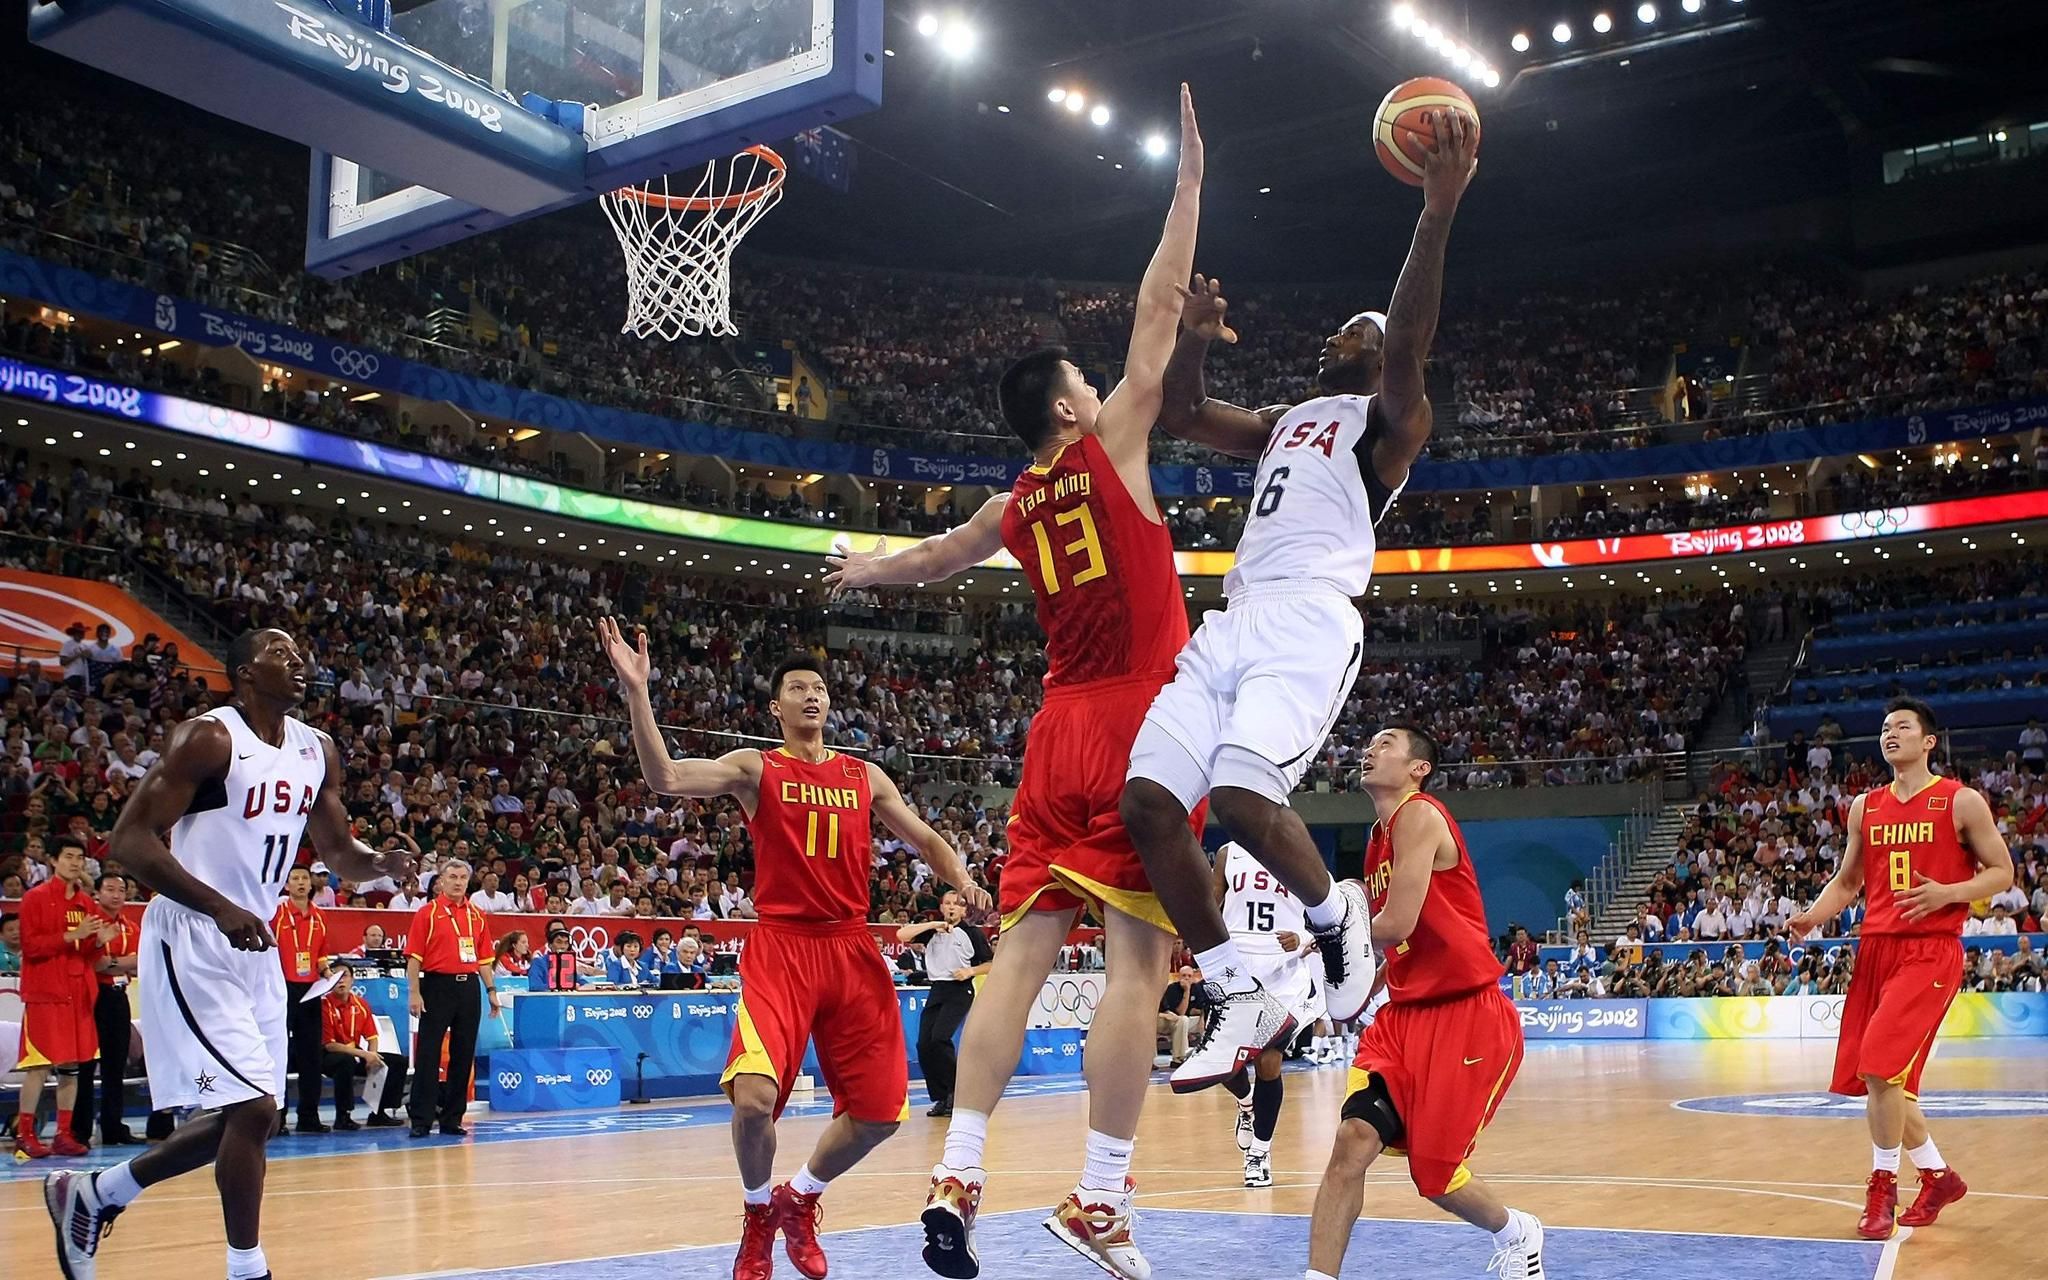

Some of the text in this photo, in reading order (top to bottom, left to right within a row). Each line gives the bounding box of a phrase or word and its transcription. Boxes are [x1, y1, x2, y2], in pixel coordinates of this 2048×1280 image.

[274, 1, 503, 133] Beijing 2008
[200, 312, 314, 361] Beijing 2008
[63, 375, 142, 417] 2008
[1261, 420, 1341, 464] USA
[1946, 409, 2011, 434] Beijing
[908, 457, 1007, 481] Beijing 2008
[1017, 472, 1091, 518] Yao Ming
[1255, 465, 1290, 517] 6
[1031, 502, 1107, 595] 13
[1662, 520, 1804, 554] Beijing 2008
[243, 780, 313, 820] USA
[781, 780, 859, 810] CHINA
[806, 811, 838, 859] 11
[1870, 821, 1934, 846] CHINA
[261, 834, 289, 885] 11
[1889, 850, 1911, 891] 8
[1233, 870, 1289, 898] USA
[1246, 901, 1275, 932] 15
[1517, 1005, 1639, 1034] Beijing 2008
